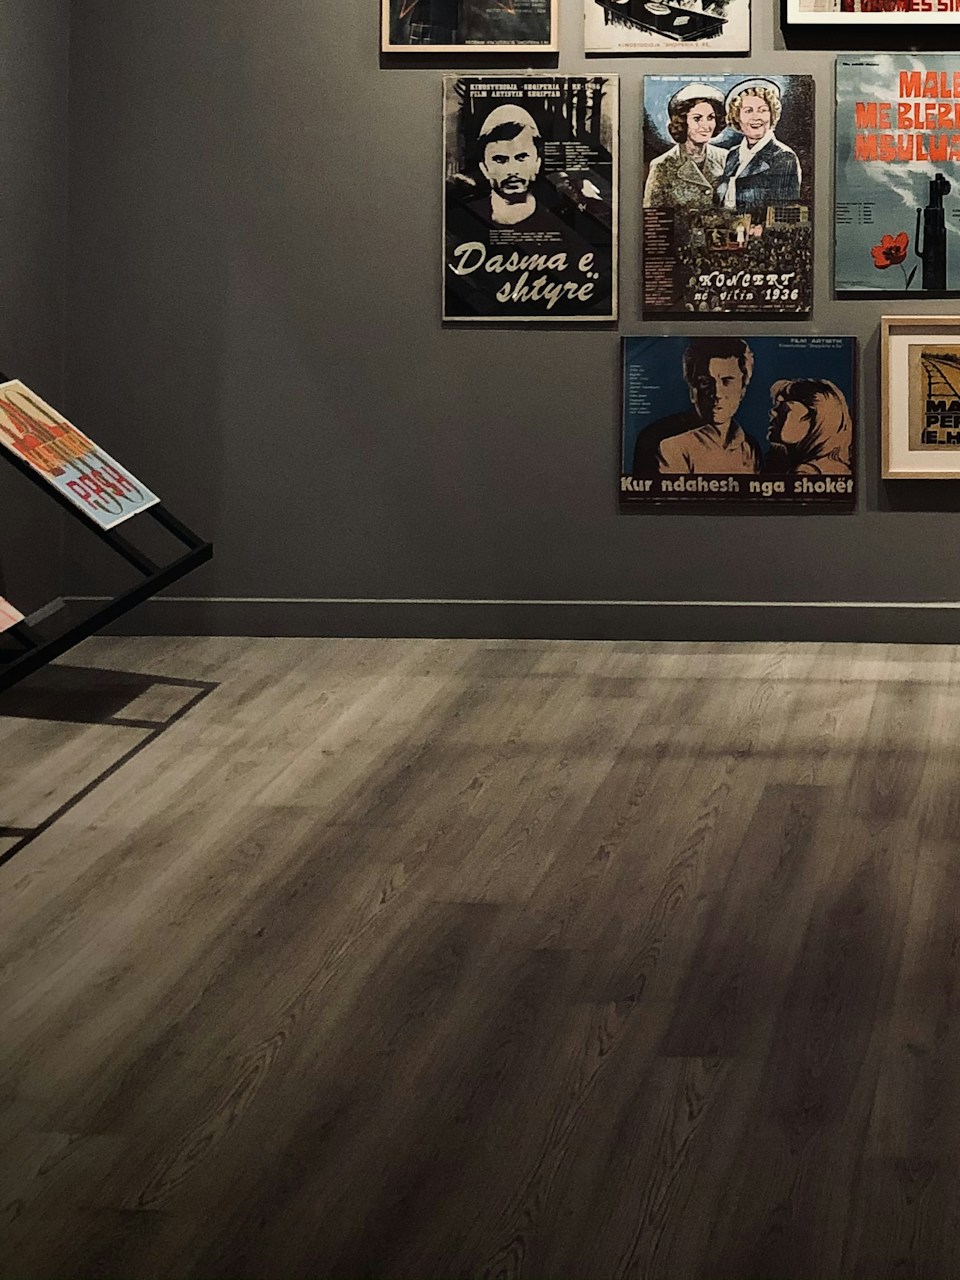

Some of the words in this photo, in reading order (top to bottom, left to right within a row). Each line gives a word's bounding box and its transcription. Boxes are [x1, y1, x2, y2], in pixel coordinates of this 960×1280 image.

[855, 102, 892, 130] ME
[448, 241, 569, 276] Dasma
[578, 252, 595, 272] e
[496, 271, 600, 310] shtyrë
[699, 270, 796, 289] KONCERT
[719, 288, 755, 301] vitin
[765, 288, 799, 301] 1936
[620, 476, 653, 493] Kur
[661, 476, 740, 493] ndahesh
[749, 480, 786, 497] nga
